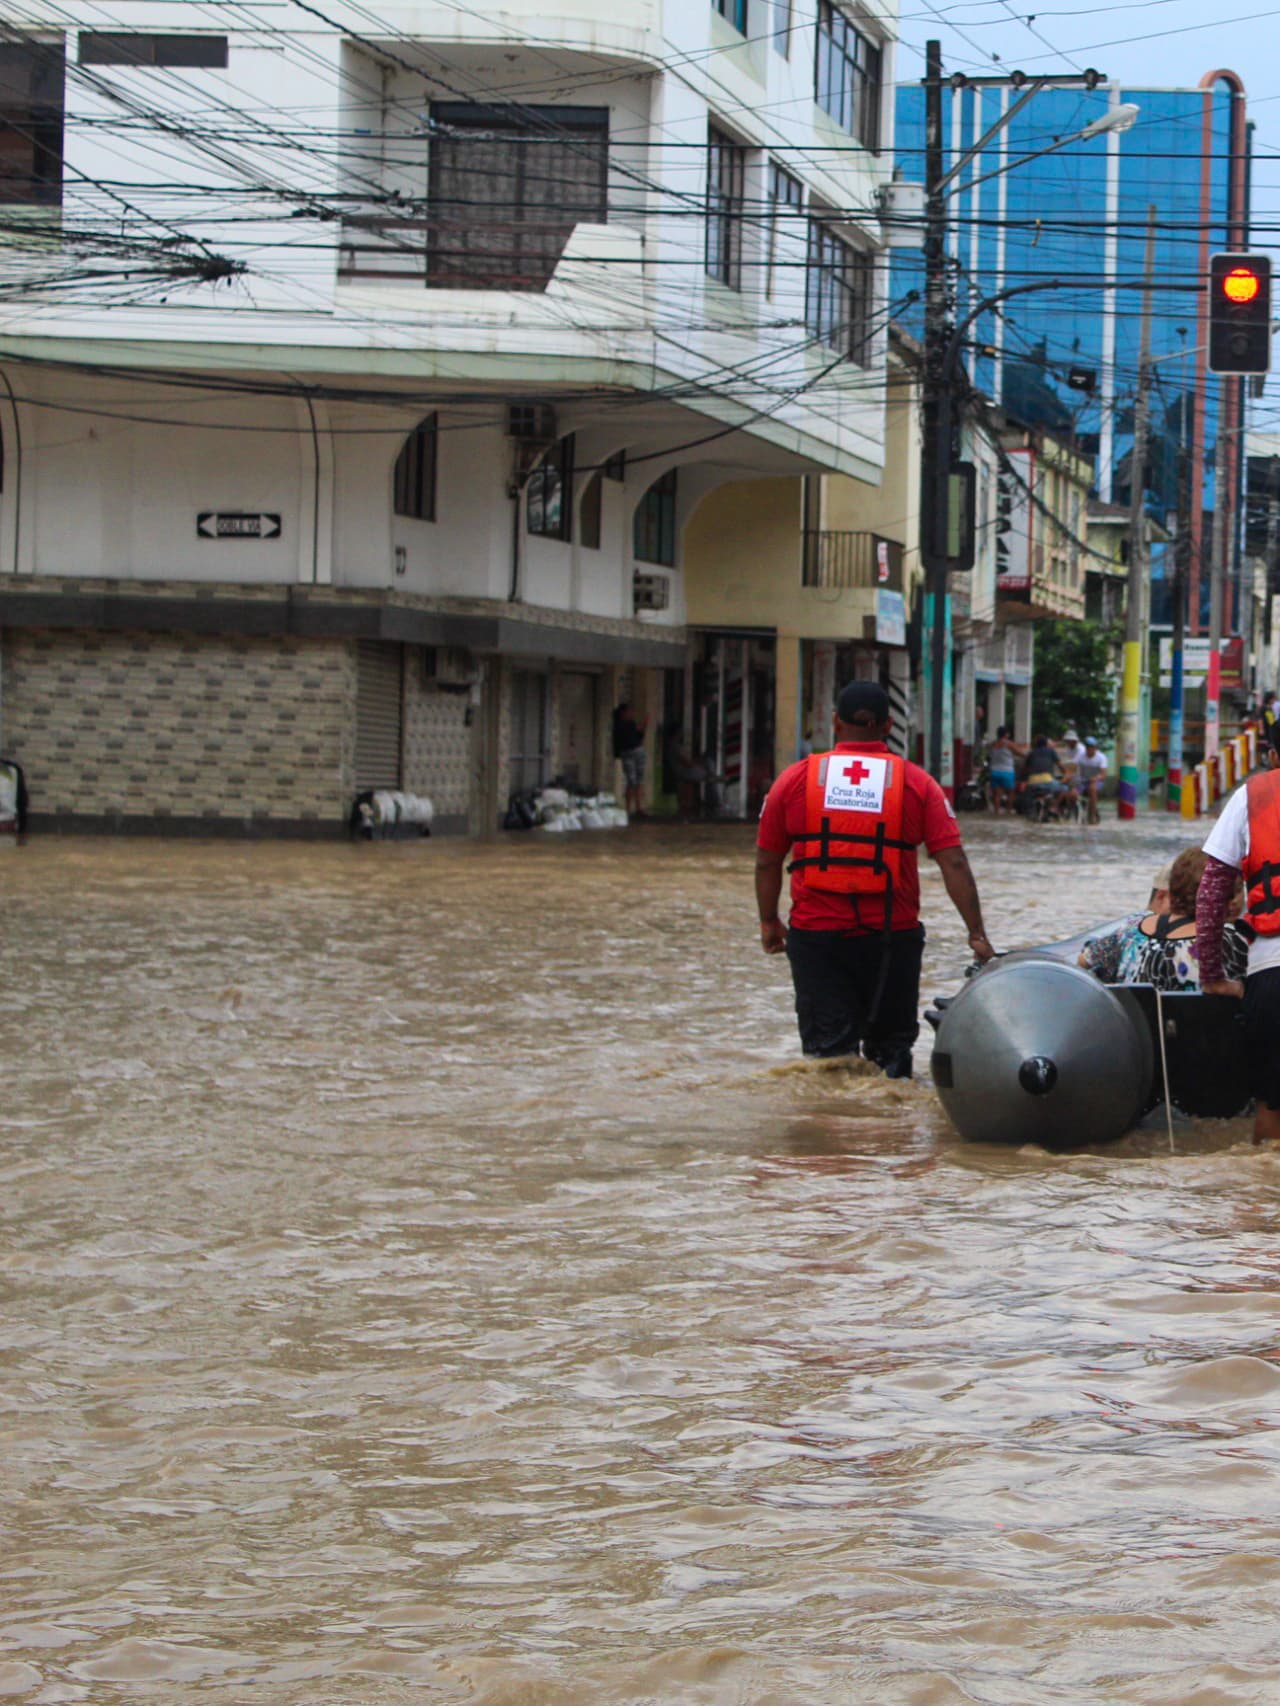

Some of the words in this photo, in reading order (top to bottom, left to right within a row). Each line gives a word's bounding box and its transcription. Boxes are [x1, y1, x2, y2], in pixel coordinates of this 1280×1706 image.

[832, 786, 853, 797] Cruz
[855, 788, 875, 800] Roja
[827, 796, 879, 808] Ecuatoriana
